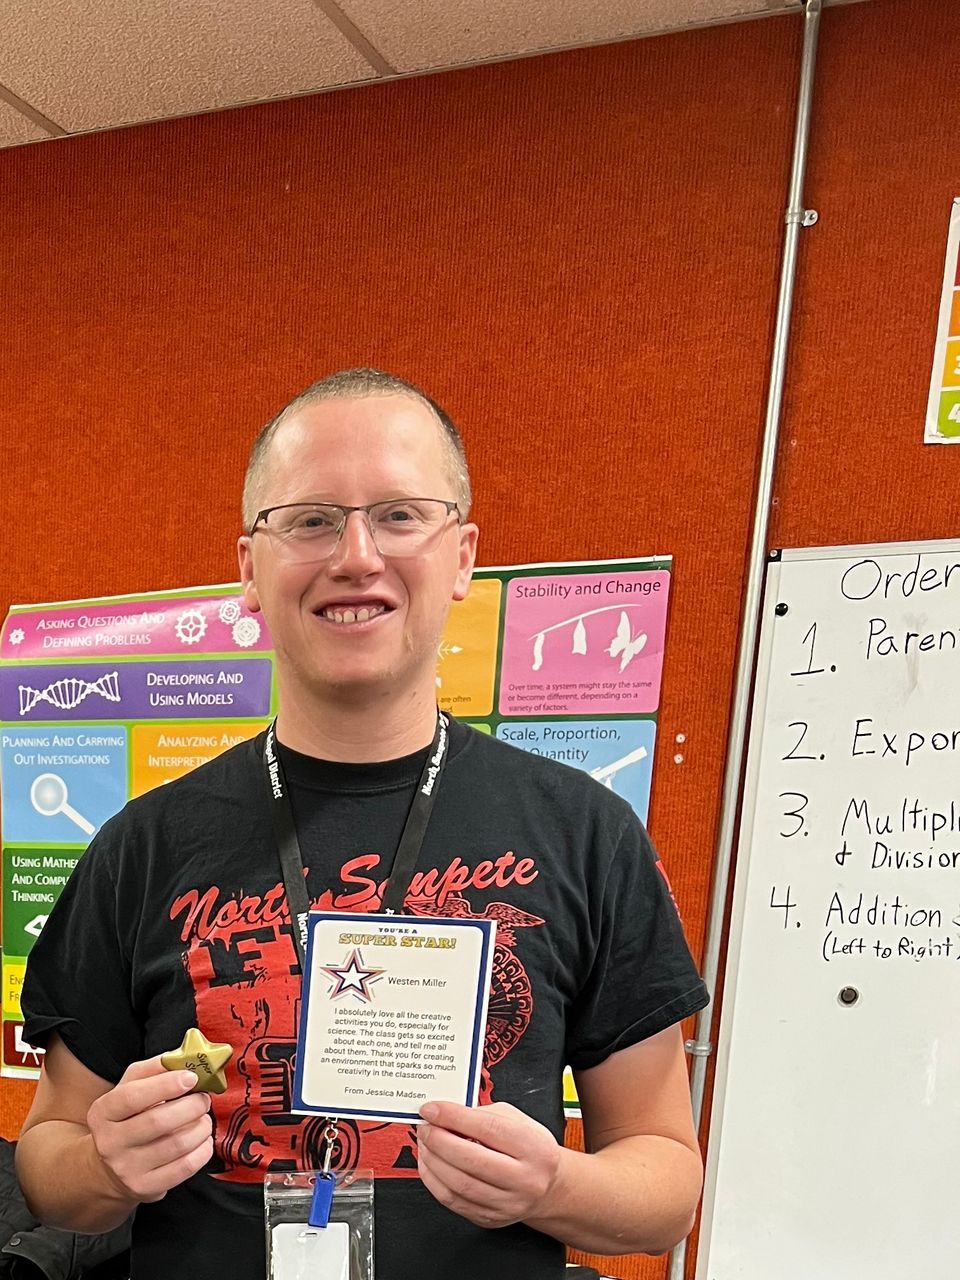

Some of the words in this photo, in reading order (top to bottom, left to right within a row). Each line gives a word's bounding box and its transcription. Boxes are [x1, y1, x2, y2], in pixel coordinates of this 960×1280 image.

[515, 584, 572, 599] Stability
[575, 581, 602, 595] and
[605, 580, 662, 596] Change
[790, 621, 837, 676] 1.
[866, 618, 958, 660] Paren
[552, 683, 577, 691] system
[579, 681, 600, 690] might
[602, 681, 617, 690] stay
[618, 680, 630, 689] the
[632, 680, 652, 688] same
[517, 693, 545, 701] become
[580, 690, 620, 700] depending
[533, 703, 541, 711] of
[502, 728, 539, 741] Scale,
[543, 727, 621, 743] Proportion,
[782, 722, 825, 761] 2.
[778, 792, 809, 837] 3.
[770, 885, 801, 928] 4.
[826, 892, 941, 927] Addition
[338, 933, 397, 947] SUPER
[400, 935, 457, 949] STAR!
[822, 931, 867, 962] (Left
[872, 940, 892, 959] to
[388, 977, 420, 986] Westen
[422, 978, 447, 987] Miller
[339, 1008, 377, 1017] absolutely
[407, 1011, 419, 1019] the
[421, 1013, 451, 1021] creative
[335, 1018, 368, 1026] activities
[385, 1020, 397, 1028] do,
[399, 1021, 436, 1031] especially
[334, 1037, 355, 1045] about
[376, 1029, 396, 1037] class
[398, 1031, 414, 1039] gets
[427, 1033, 455, 1041] excited
[324, 1047, 346, 1055] about
[347, 1048, 368, 1056] them.
[371, 1049, 394, 1057] Thank
[395, 1052, 409, 1060] you
[423, 1053, 455, 1062] creating
[331, 1058, 378, 1066] environment
[396, 1061, 421, 1069] sparks
[435, 1063, 456, 1071] much
[337, 1067, 371, 1077] creativity
[381, 1069, 394, 1077] the
[395, 1071, 436, 1079] classroom.
[365, 1089, 394, 1097] Jessica
[396, 1090, 426, 1098] Madsen
